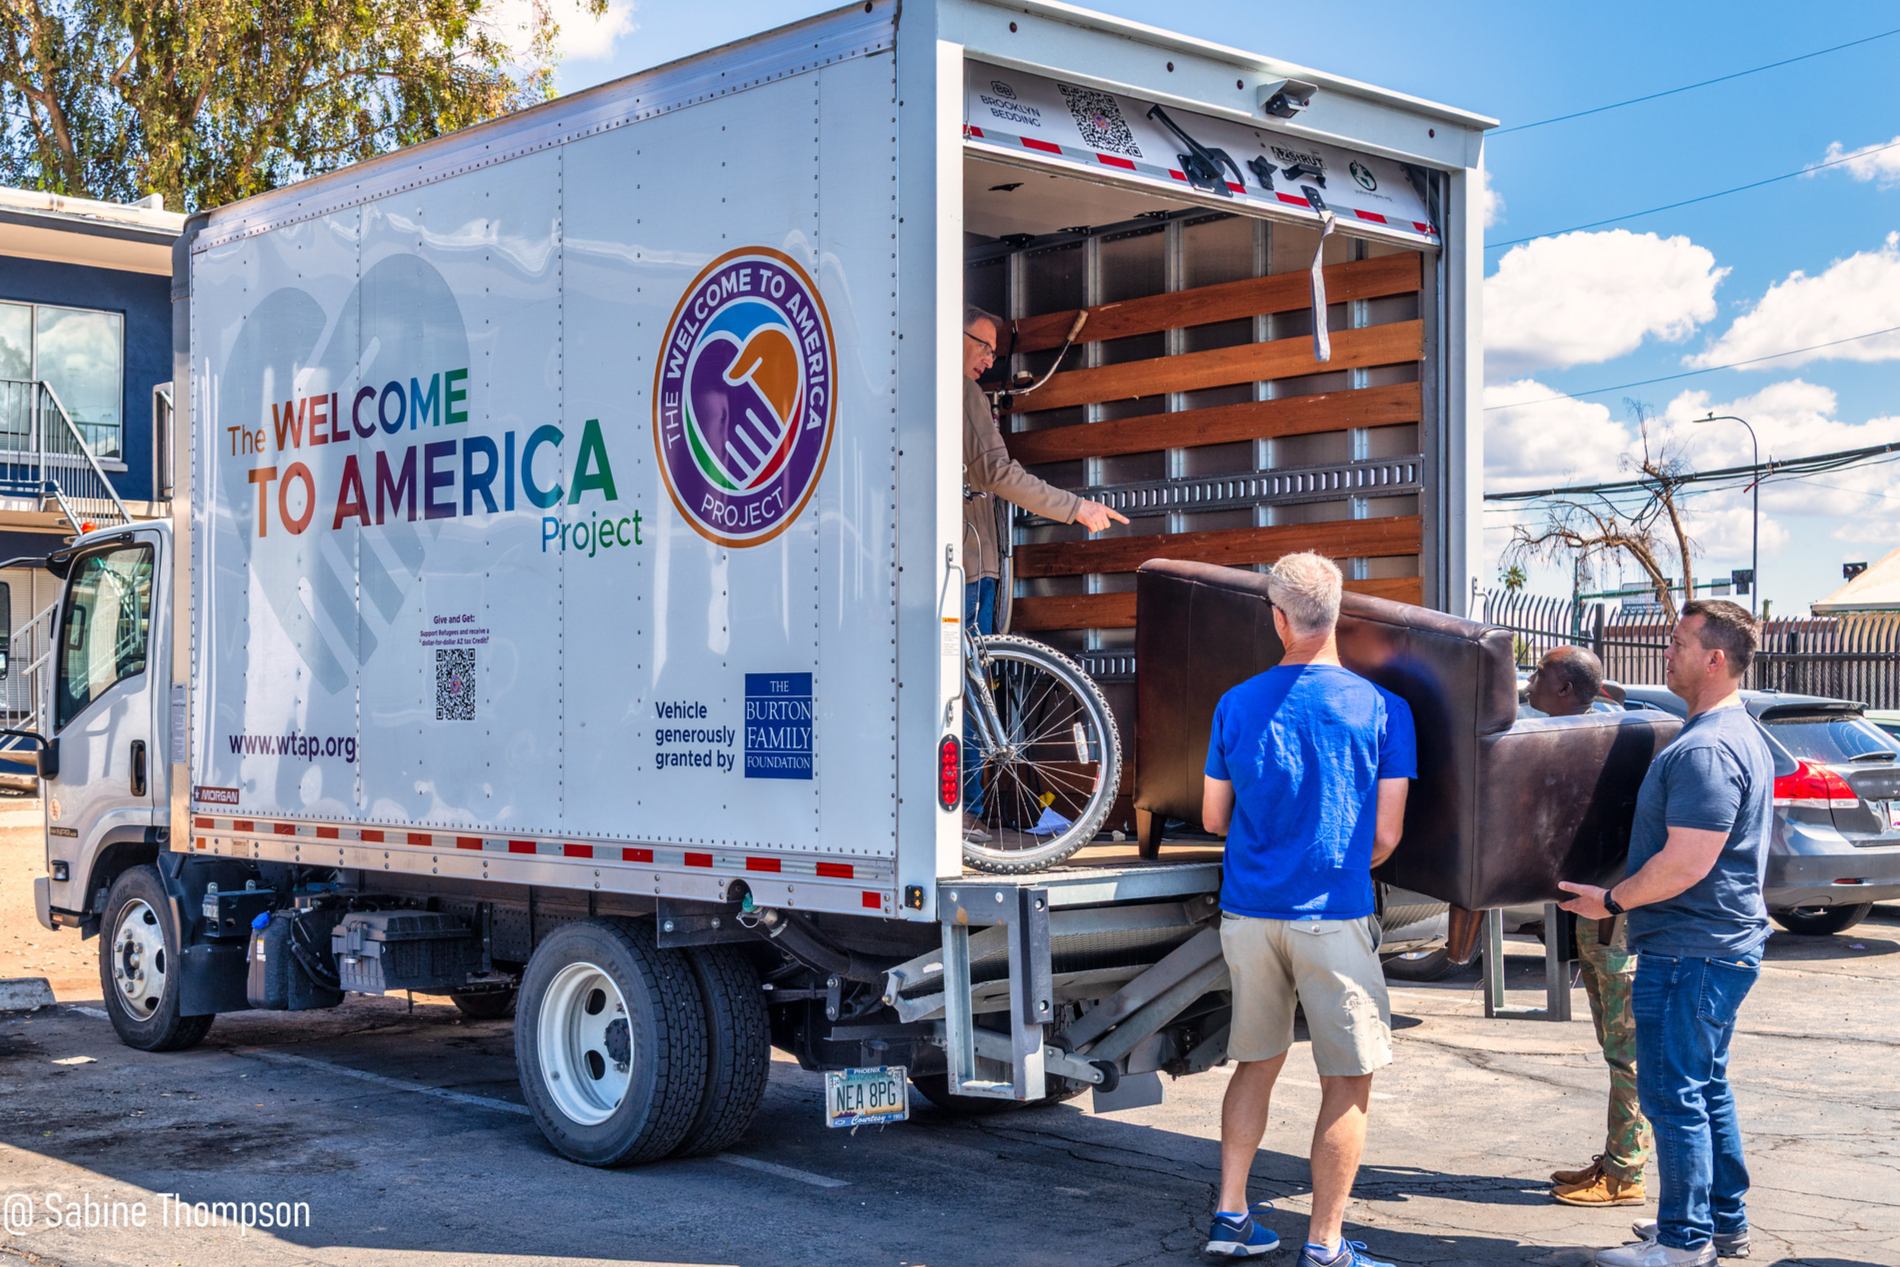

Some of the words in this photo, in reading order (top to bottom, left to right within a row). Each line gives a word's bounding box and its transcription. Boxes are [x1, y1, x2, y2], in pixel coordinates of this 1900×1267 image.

[980, 94, 1041, 117] BROOKLYN
[990, 107, 1041, 127] BEDDING
[759, 268, 786, 298] TO
[667, 268, 752, 379] WELCOME
[785, 293, 825, 431] AMERICA
[227, 424, 266, 456] The
[272, 367, 469, 451] WELCOME
[665, 391, 681, 449] THE
[248, 461, 316, 538] TO
[332, 418, 618, 530] AMERICA
[701, 487, 785, 527] PROJECT
[541, 510, 643, 558] Project
[433, 615, 447, 624] Give
[448, 614, 460, 623] and
[461, 614, 475, 623] Get:
[438, 629, 459, 637] Refugees
[469, 627, 486, 635] receive
[769, 680, 789, 693] THE
[655, 700, 708, 719] Vehicle
[746, 701, 812, 720] BURTON
[229, 731, 356, 763] www.wtap.org
[655, 725, 735, 748] generously
[747, 727, 812, 749] FAMILY
[655, 749, 712, 770] granted
[717, 749, 735, 772] by
[747, 755, 811, 769] FOUNDATION
[201, 789, 239, 803] MORGAN
[853, 1067, 880, 1075] PHOENIX
[836, 1084, 864, 1111] NEA
[869, 1081, 896, 1107] 8PG
[850, 1114, 886, 1125] Courtesy
